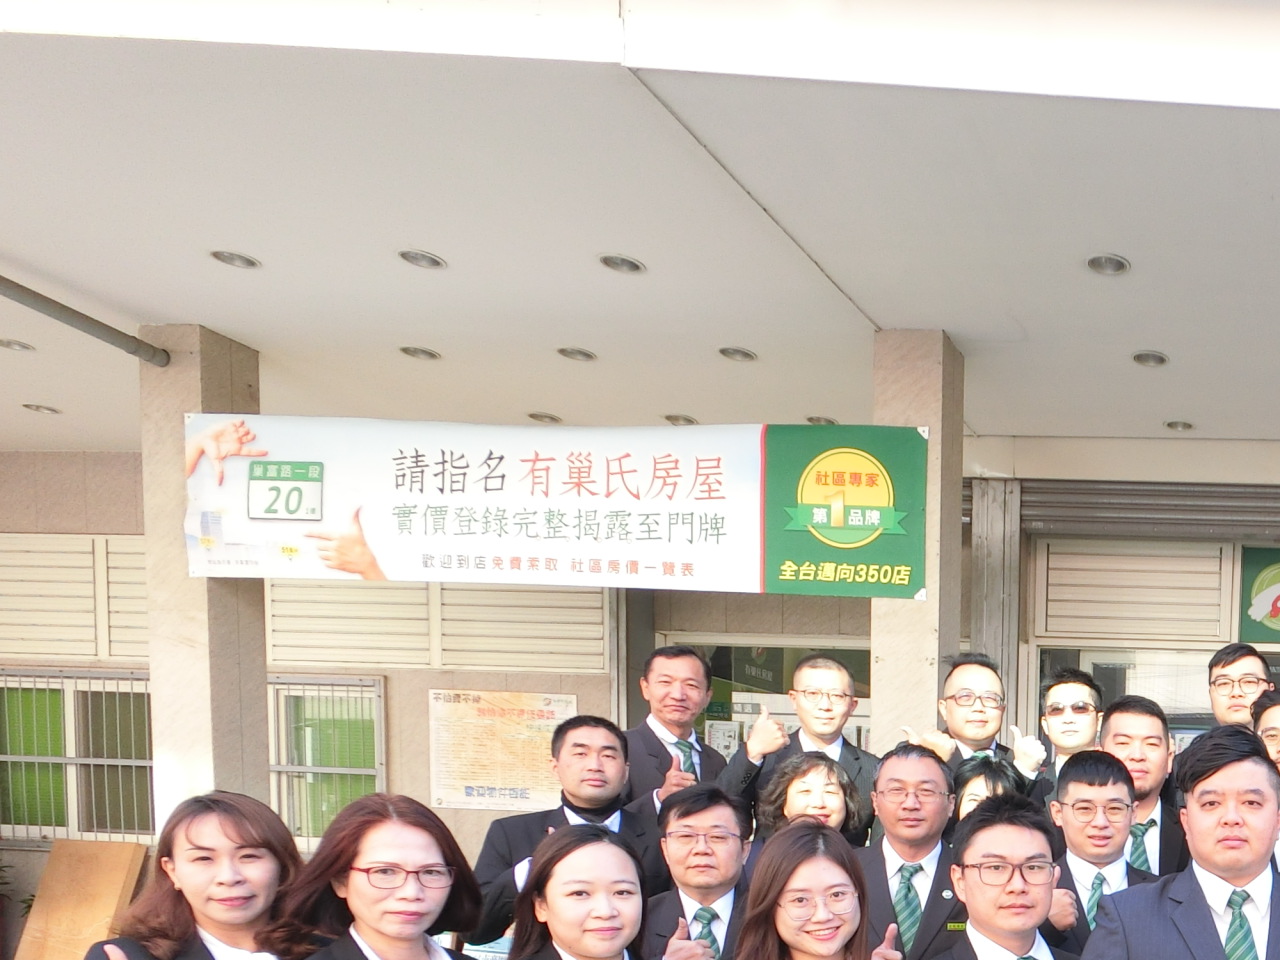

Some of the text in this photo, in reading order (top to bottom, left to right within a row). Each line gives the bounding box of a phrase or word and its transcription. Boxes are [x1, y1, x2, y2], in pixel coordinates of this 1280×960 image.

[391, 447, 727, 501] 請指名有巢氏房屋
[815, 470, 880, 488] 社區專家
[263, 485, 304, 515] 20
[391, 502, 728, 545] 實價登錄完整揭露至門牌
[421, 553, 695, 577] 歡迎到店免費索取 社區房價一覽表
[778, 560, 912, 586] 全台邁向350店
